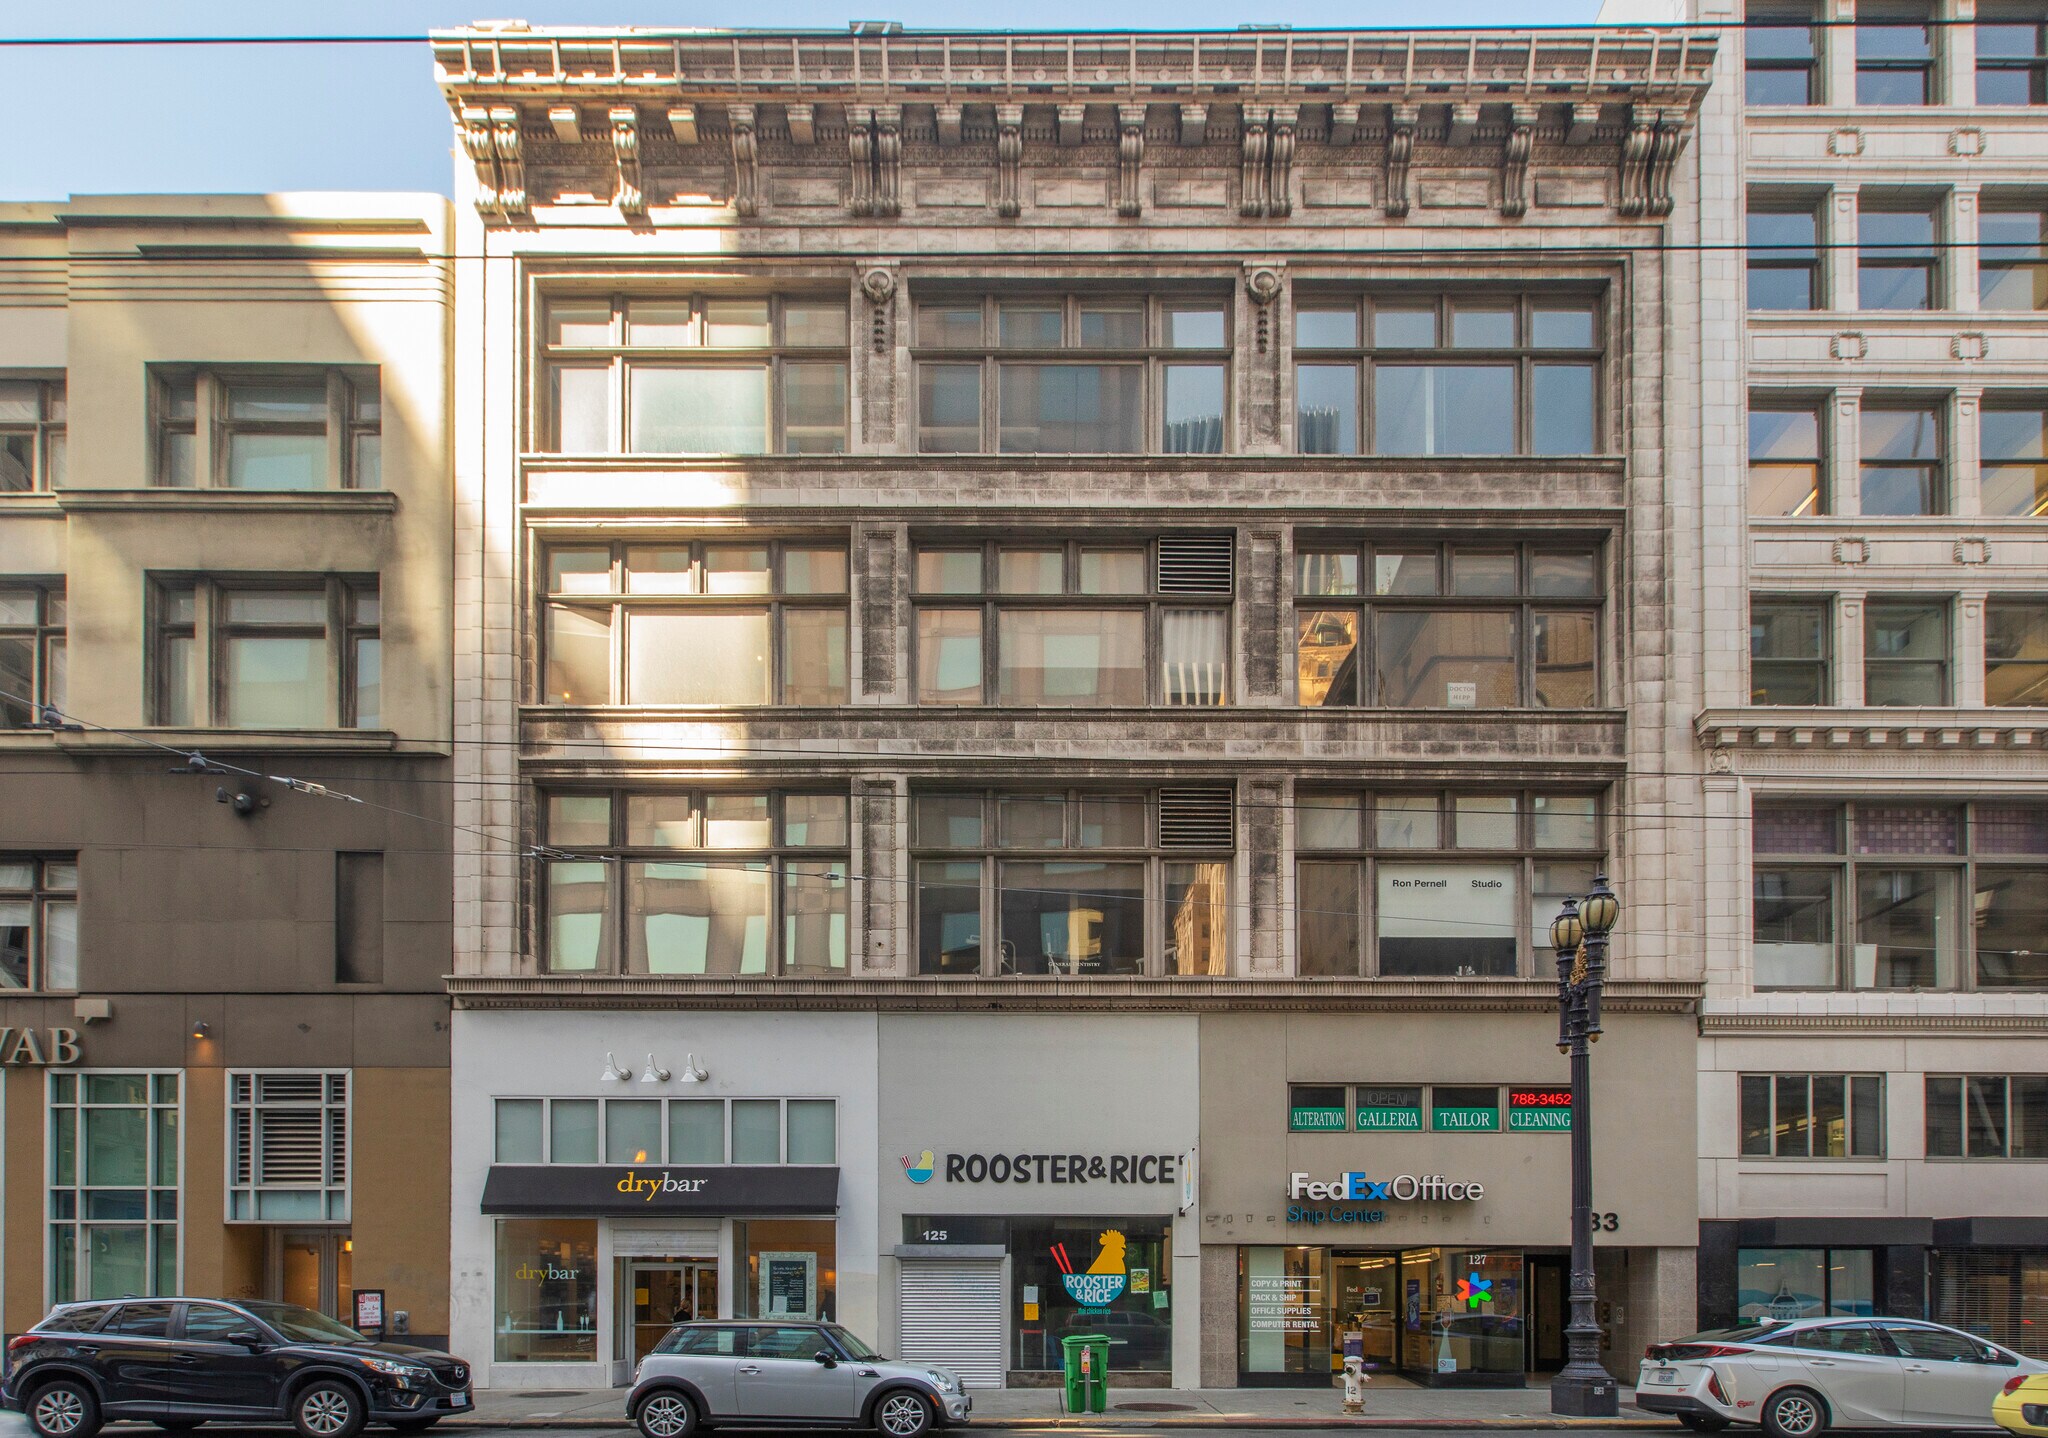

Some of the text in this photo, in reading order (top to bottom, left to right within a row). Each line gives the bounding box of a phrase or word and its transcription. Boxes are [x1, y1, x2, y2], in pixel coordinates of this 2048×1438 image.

[1392, 879, 1503, 888] Ron Pernell Studio
[0, 1027, 81, 1064] AB
[1369, 1091, 1406, 1105] OPEN
[1511, 1093, 1572, 1105] 788-3452
[1292, 1111, 1571, 1127] ALTERATION GALLERIA TAILOR CLEANING
[616, 1171, 706, 1202] drybar
[1289, 1171, 1485, 1201] FedEx Office
[1287, 1206, 1386, 1224] Ship Center
[922, 1230, 948, 1241] 125
[1468, 1254, 1487, 1265] 127
[515, 1263, 580, 1288] drybar
[1066, 1275, 1124, 1289] ROOSTER
[1251, 1280, 1303, 1288] COPY & PRINT
[1075, 1289, 1112, 1303] &RICE
[1251, 1293, 1271, 1302] PACK
[1279, 1293, 1297, 1302] SHIP
[1251, 1307, 1312, 1315] OFFICE SUPPLIES
[1251, 1320, 1319, 1328] COMPUTER RENTAL
[1347, 1386, 1357, 1395] 12
